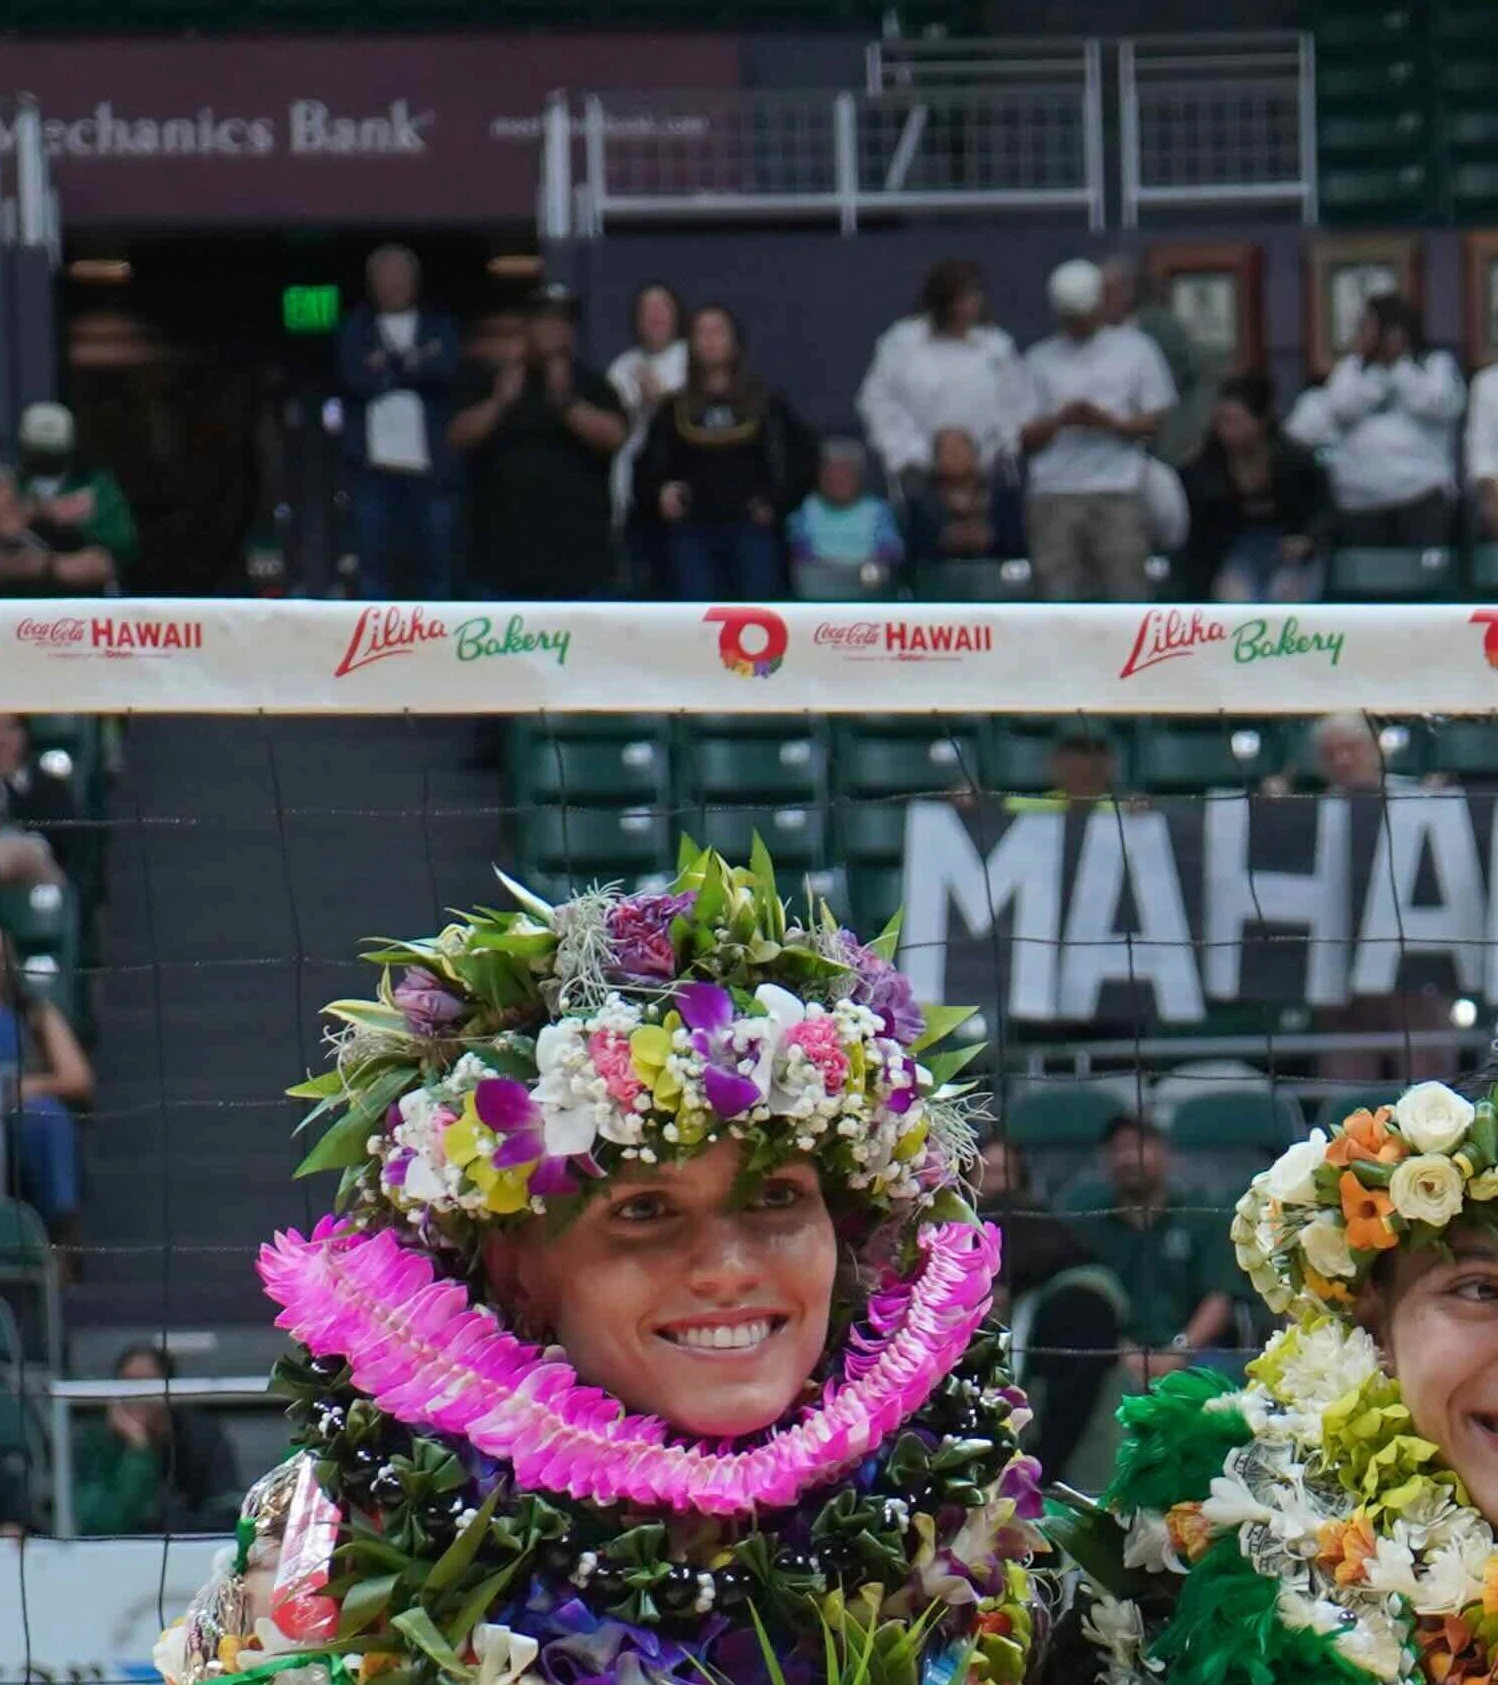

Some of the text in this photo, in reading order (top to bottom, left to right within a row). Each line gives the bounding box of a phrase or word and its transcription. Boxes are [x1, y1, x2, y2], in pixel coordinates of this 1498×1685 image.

[288, 98, 429, 156] Bank
[92, 618, 203, 648] HAWAII
[336, 606, 571, 677] Liliha Bakery
[885, 621, 992, 652] HAWAII
[1119, 608, 1344, 678] Liliha Bakery
